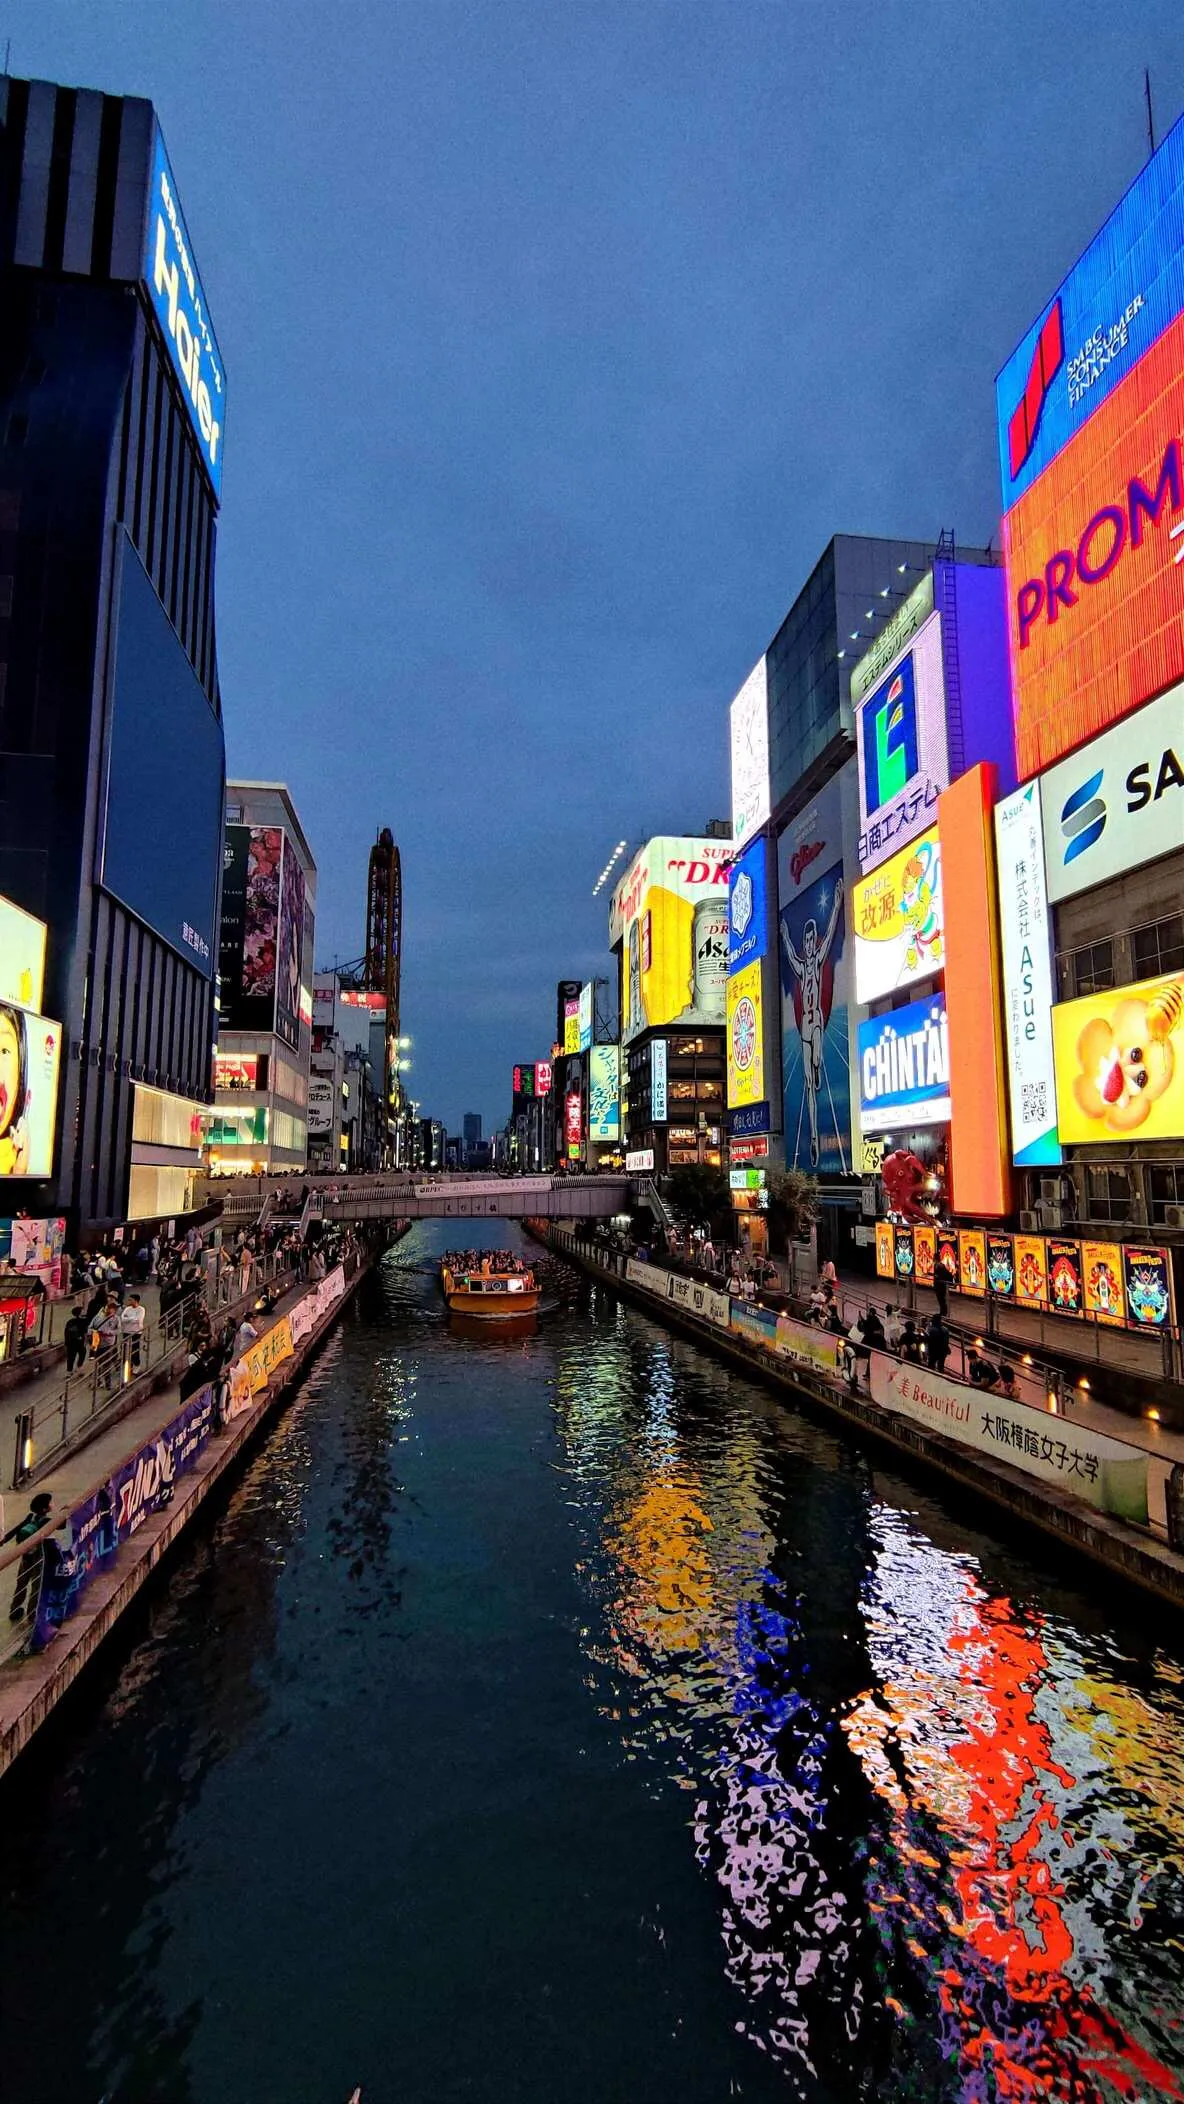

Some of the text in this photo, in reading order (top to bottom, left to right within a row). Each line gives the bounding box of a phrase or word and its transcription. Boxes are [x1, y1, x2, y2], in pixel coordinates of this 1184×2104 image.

[154, 213, 220, 465] Haier
[1067, 293, 1145, 393] CONSUMER
[1067, 324, 1103, 377] SMBC
[1069, 328, 1128, 409] FINANCE
[1016, 438, 1184, 650] PROM
[702, 847, 736, 859] SUP
[1001, 802, 1024, 824] Asue
[860, 888, 897, 935] 改源
[1015, 860, 1036, 1041] 株式会社 Asue
